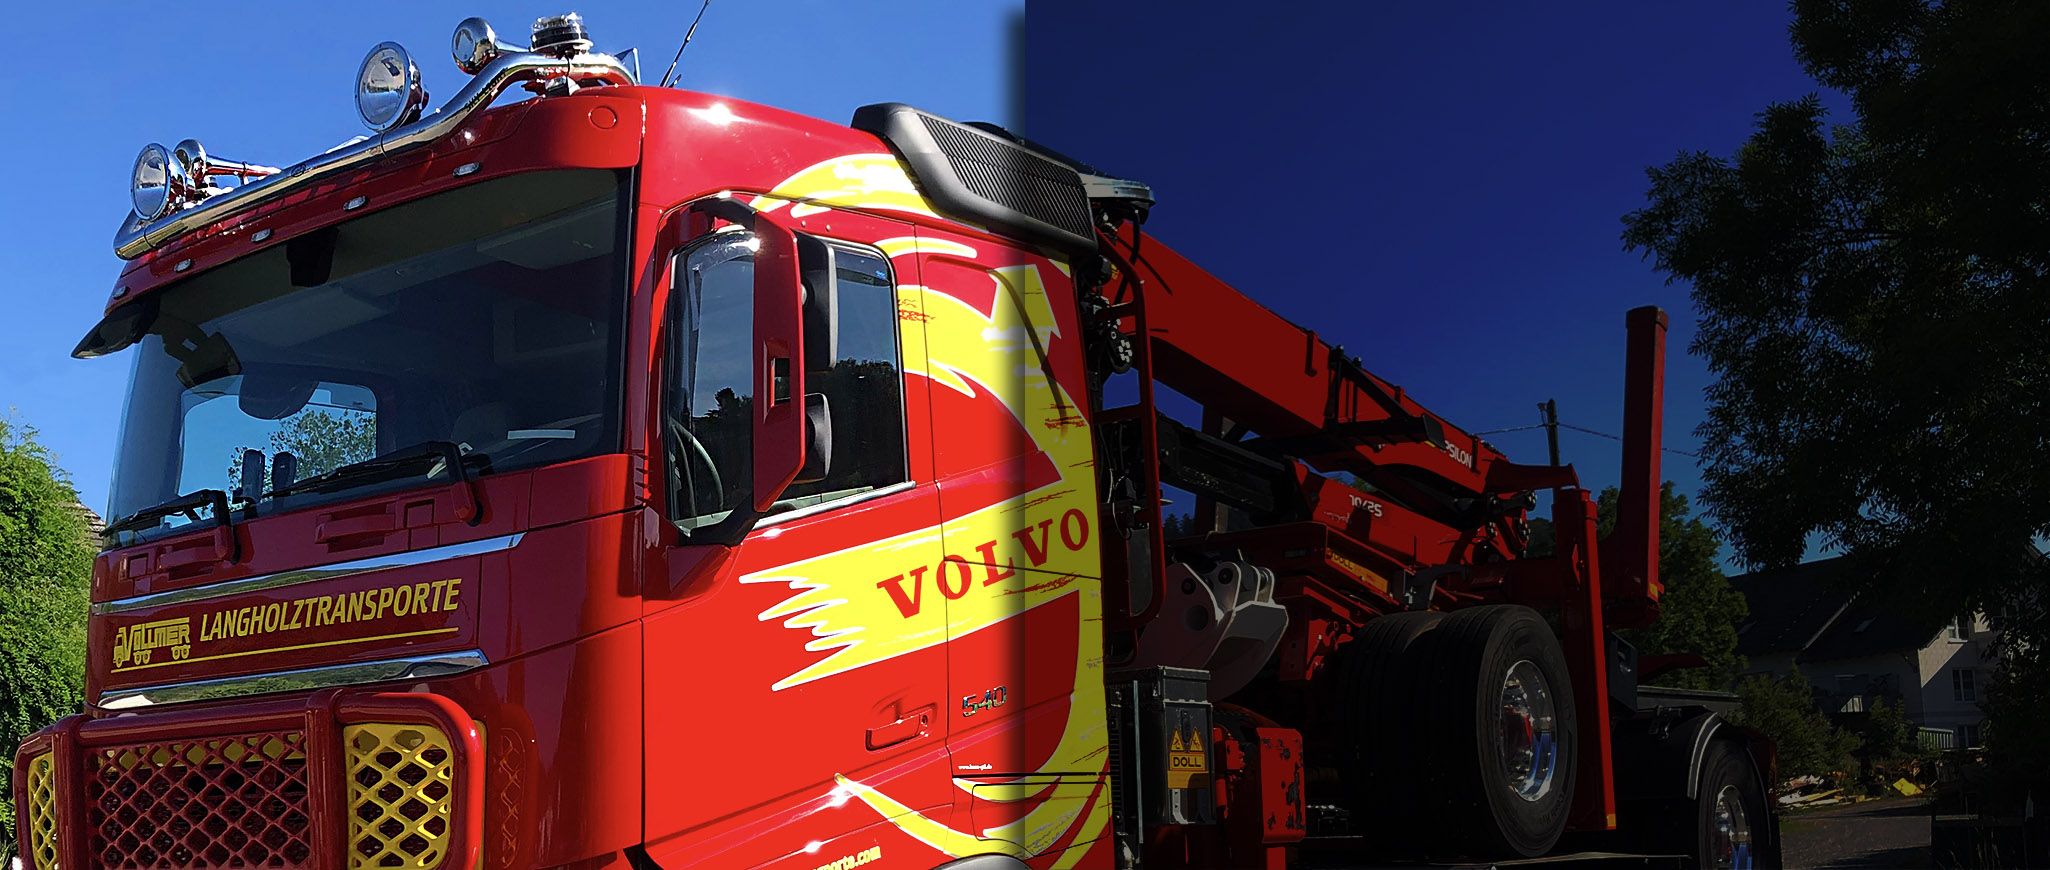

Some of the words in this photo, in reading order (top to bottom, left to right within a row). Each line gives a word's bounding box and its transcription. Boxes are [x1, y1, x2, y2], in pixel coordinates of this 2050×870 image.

[876, 507, 1089, 619] VOLVO
[125, 622, 190, 659] VOLLMER
[200, 579, 462, 642] LANGHOLZTRANSPORTE
[962, 685, 1007, 717] 540
[1173, 757, 1202, 767] DOLL
